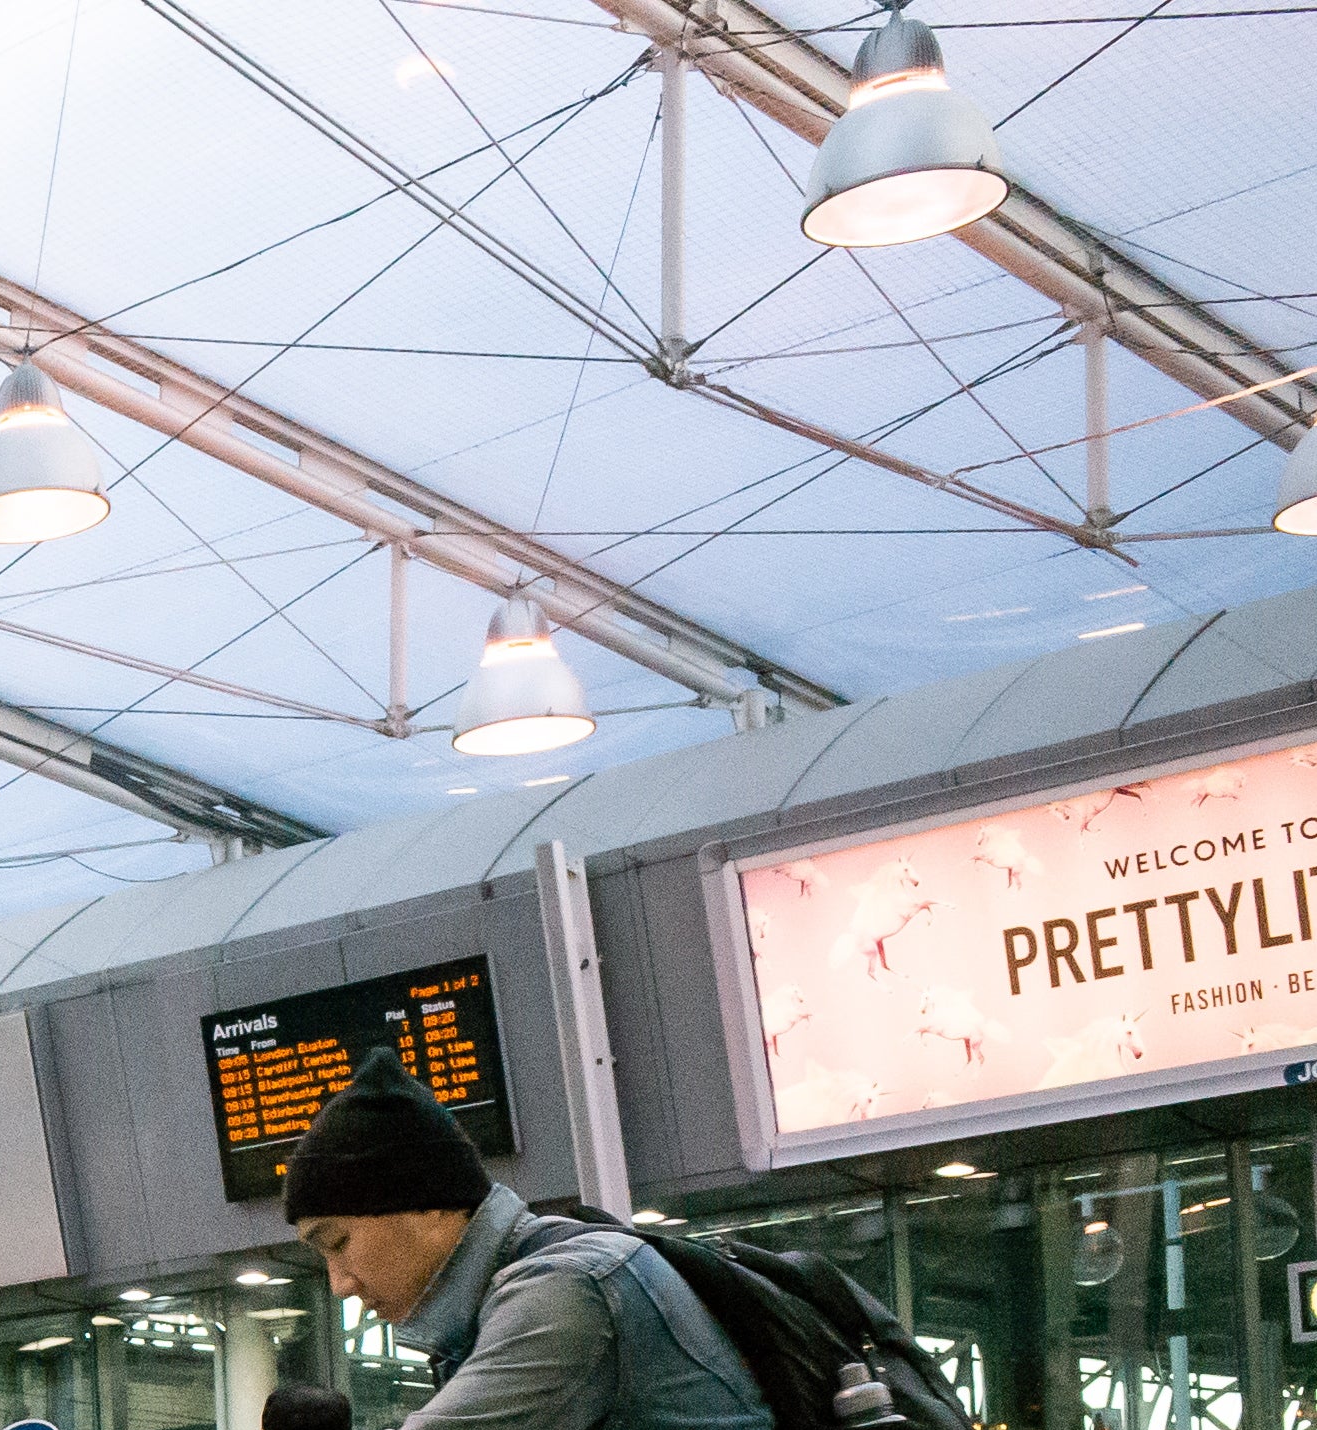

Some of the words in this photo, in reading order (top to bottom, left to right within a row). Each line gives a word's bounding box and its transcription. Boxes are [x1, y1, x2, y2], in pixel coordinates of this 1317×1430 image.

[1103, 828, 1266, 880] WELCOME
[1281, 816, 1317, 844] TO
[1003, 865, 1317, 996] PRETTYLI
[1171, 979, 1263, 1014] FASHION
[213, 1014, 278, 1040] Arrivals
[216, 1046, 240, 1058] Time
[251, 1038, 277, 1050] From
[421, 1000, 455, 1014] Status
[253, 1047, 294, 1063] London
[302, 1049, 349, 1068] Central
[257, 1072, 314, 1092] Blackpool
[318, 1064, 352, 1080] North
[262, 1100, 321, 1120] Edinburgh
